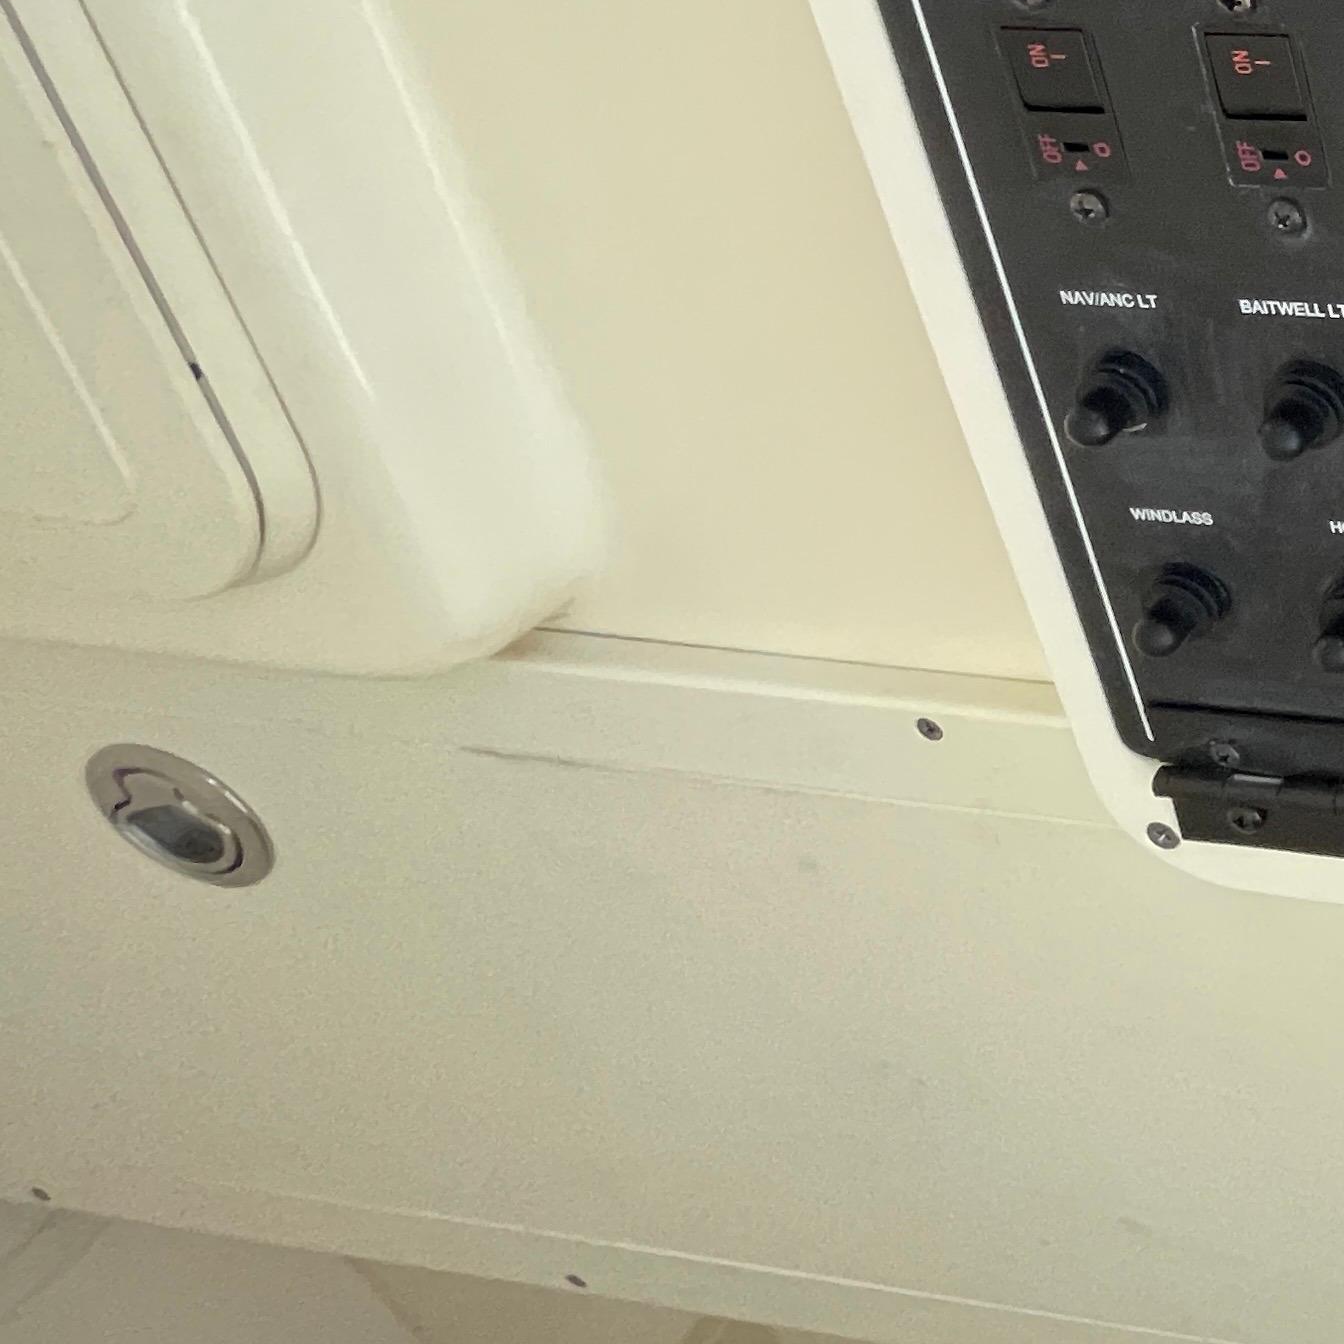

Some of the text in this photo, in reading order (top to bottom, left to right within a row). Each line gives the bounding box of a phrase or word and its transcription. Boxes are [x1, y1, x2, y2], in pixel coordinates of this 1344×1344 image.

[1027, 42, 1049, 68] ON
[1231, 49, 1254, 75] ON
[1038, 133, 1062, 163] OFF
[1236, 140, 1261, 171] OFF
[1060, 291, 1157, 308] NAV/ANC LT
[1239, 299, 1329, 317] BAITWELL
[1130, 508, 1213, 525] WINDLASS
